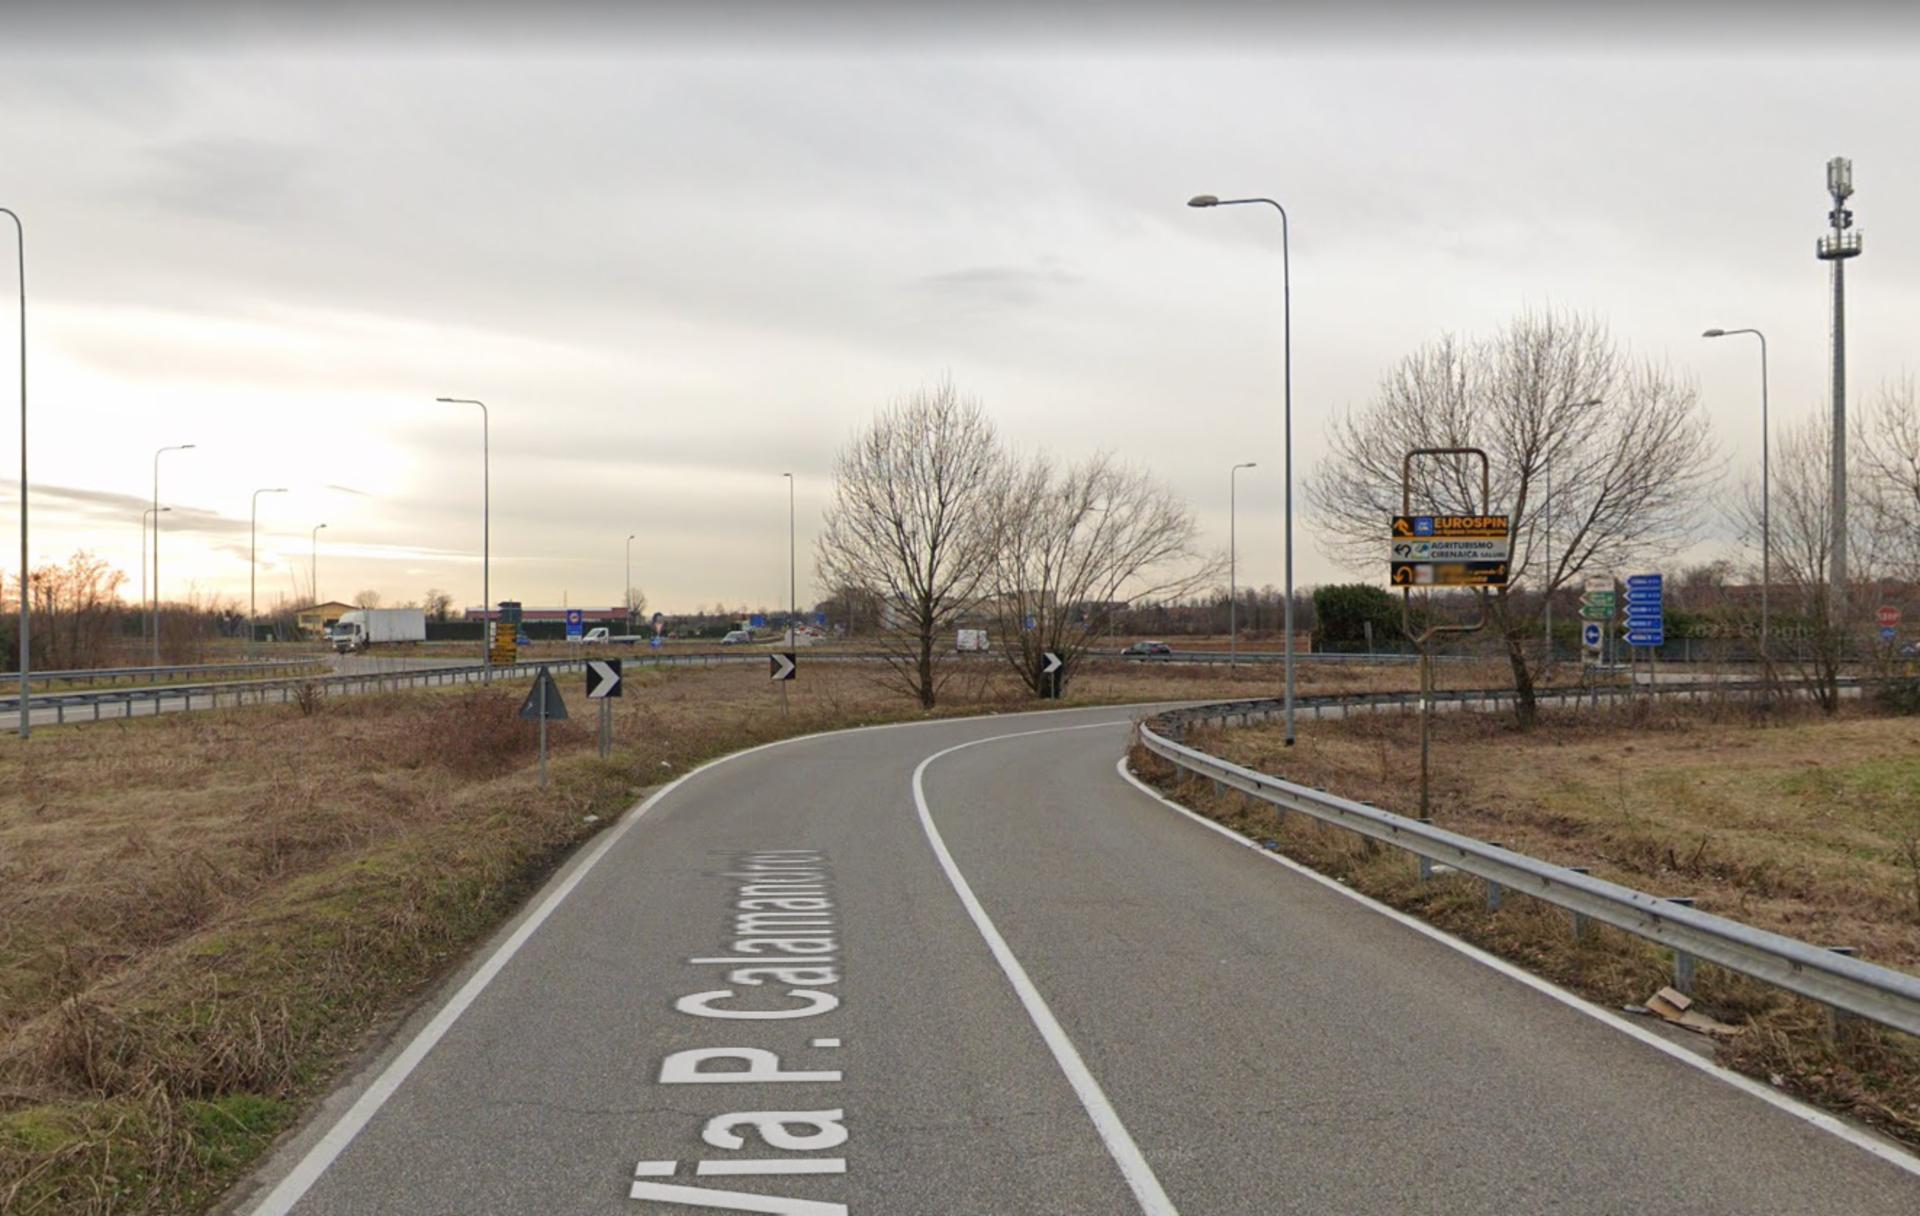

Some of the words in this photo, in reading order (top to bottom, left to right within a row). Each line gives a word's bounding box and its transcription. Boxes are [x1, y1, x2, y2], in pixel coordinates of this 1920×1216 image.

[1434, 517, 1507, 529] EUROSPIN
[1430, 541, 1494, 550] AGRITURISMO
[1430, 550, 1478, 559] CIRENAICA
